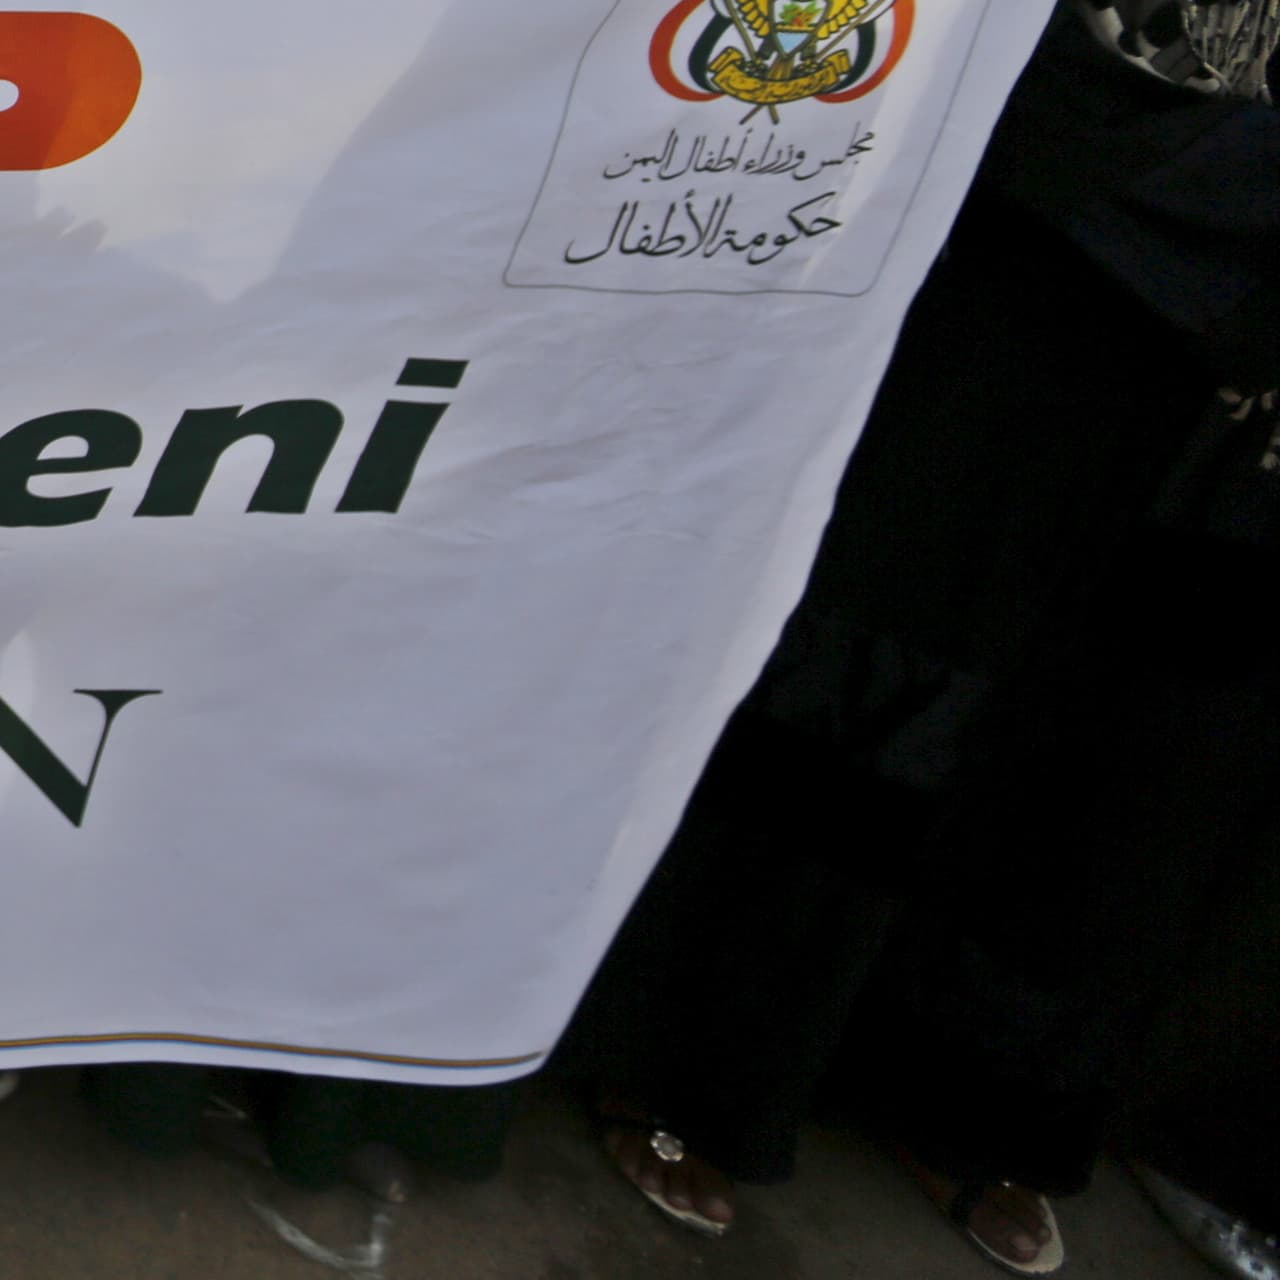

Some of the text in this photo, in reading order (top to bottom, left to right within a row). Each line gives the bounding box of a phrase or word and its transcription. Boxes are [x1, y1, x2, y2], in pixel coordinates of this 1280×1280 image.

[602, 126, 680, 183] اليمن
[563, 188, 843, 266] حكومة الأطفال
